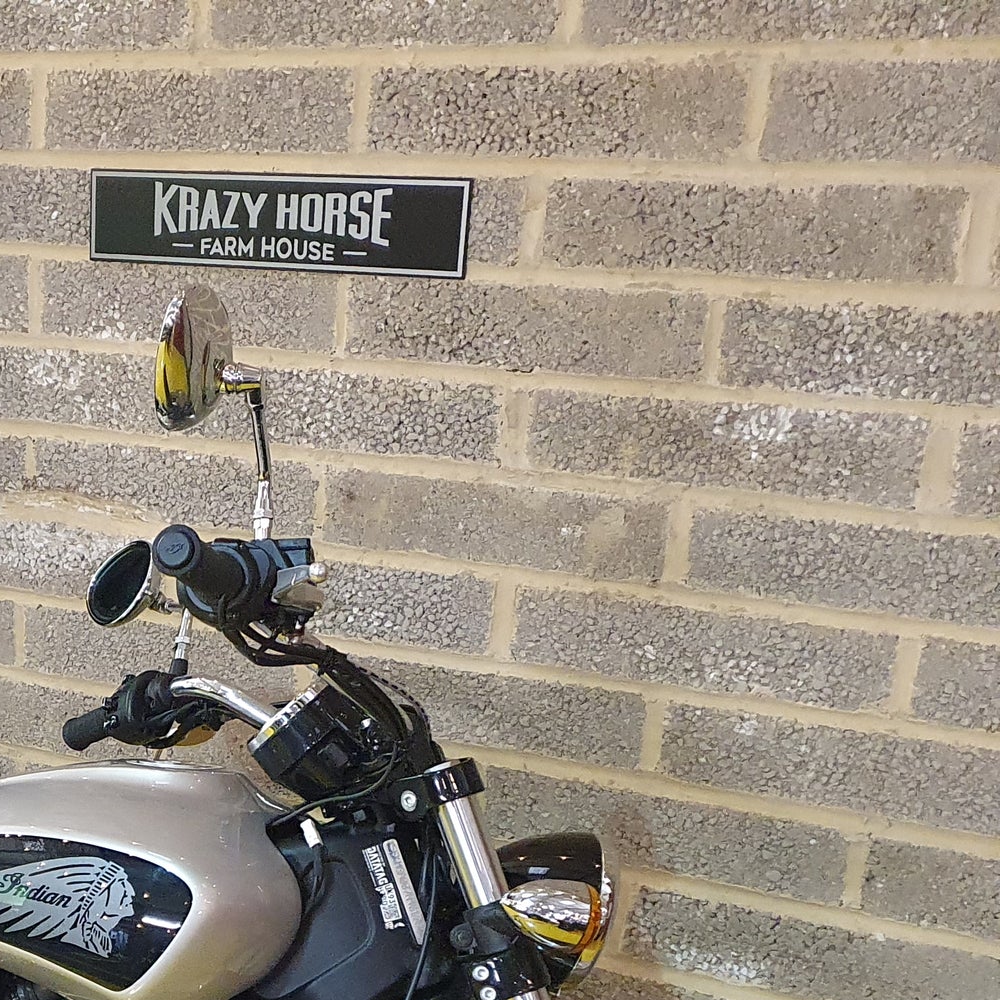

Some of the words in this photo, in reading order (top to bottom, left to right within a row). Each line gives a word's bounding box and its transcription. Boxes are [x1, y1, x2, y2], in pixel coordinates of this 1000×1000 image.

[153, 181, 269, 237] KRAZY
[275, 187, 394, 247] HORSE
[200, 236, 254, 258] FARM
[260, 236, 335, 262] HOUSE
